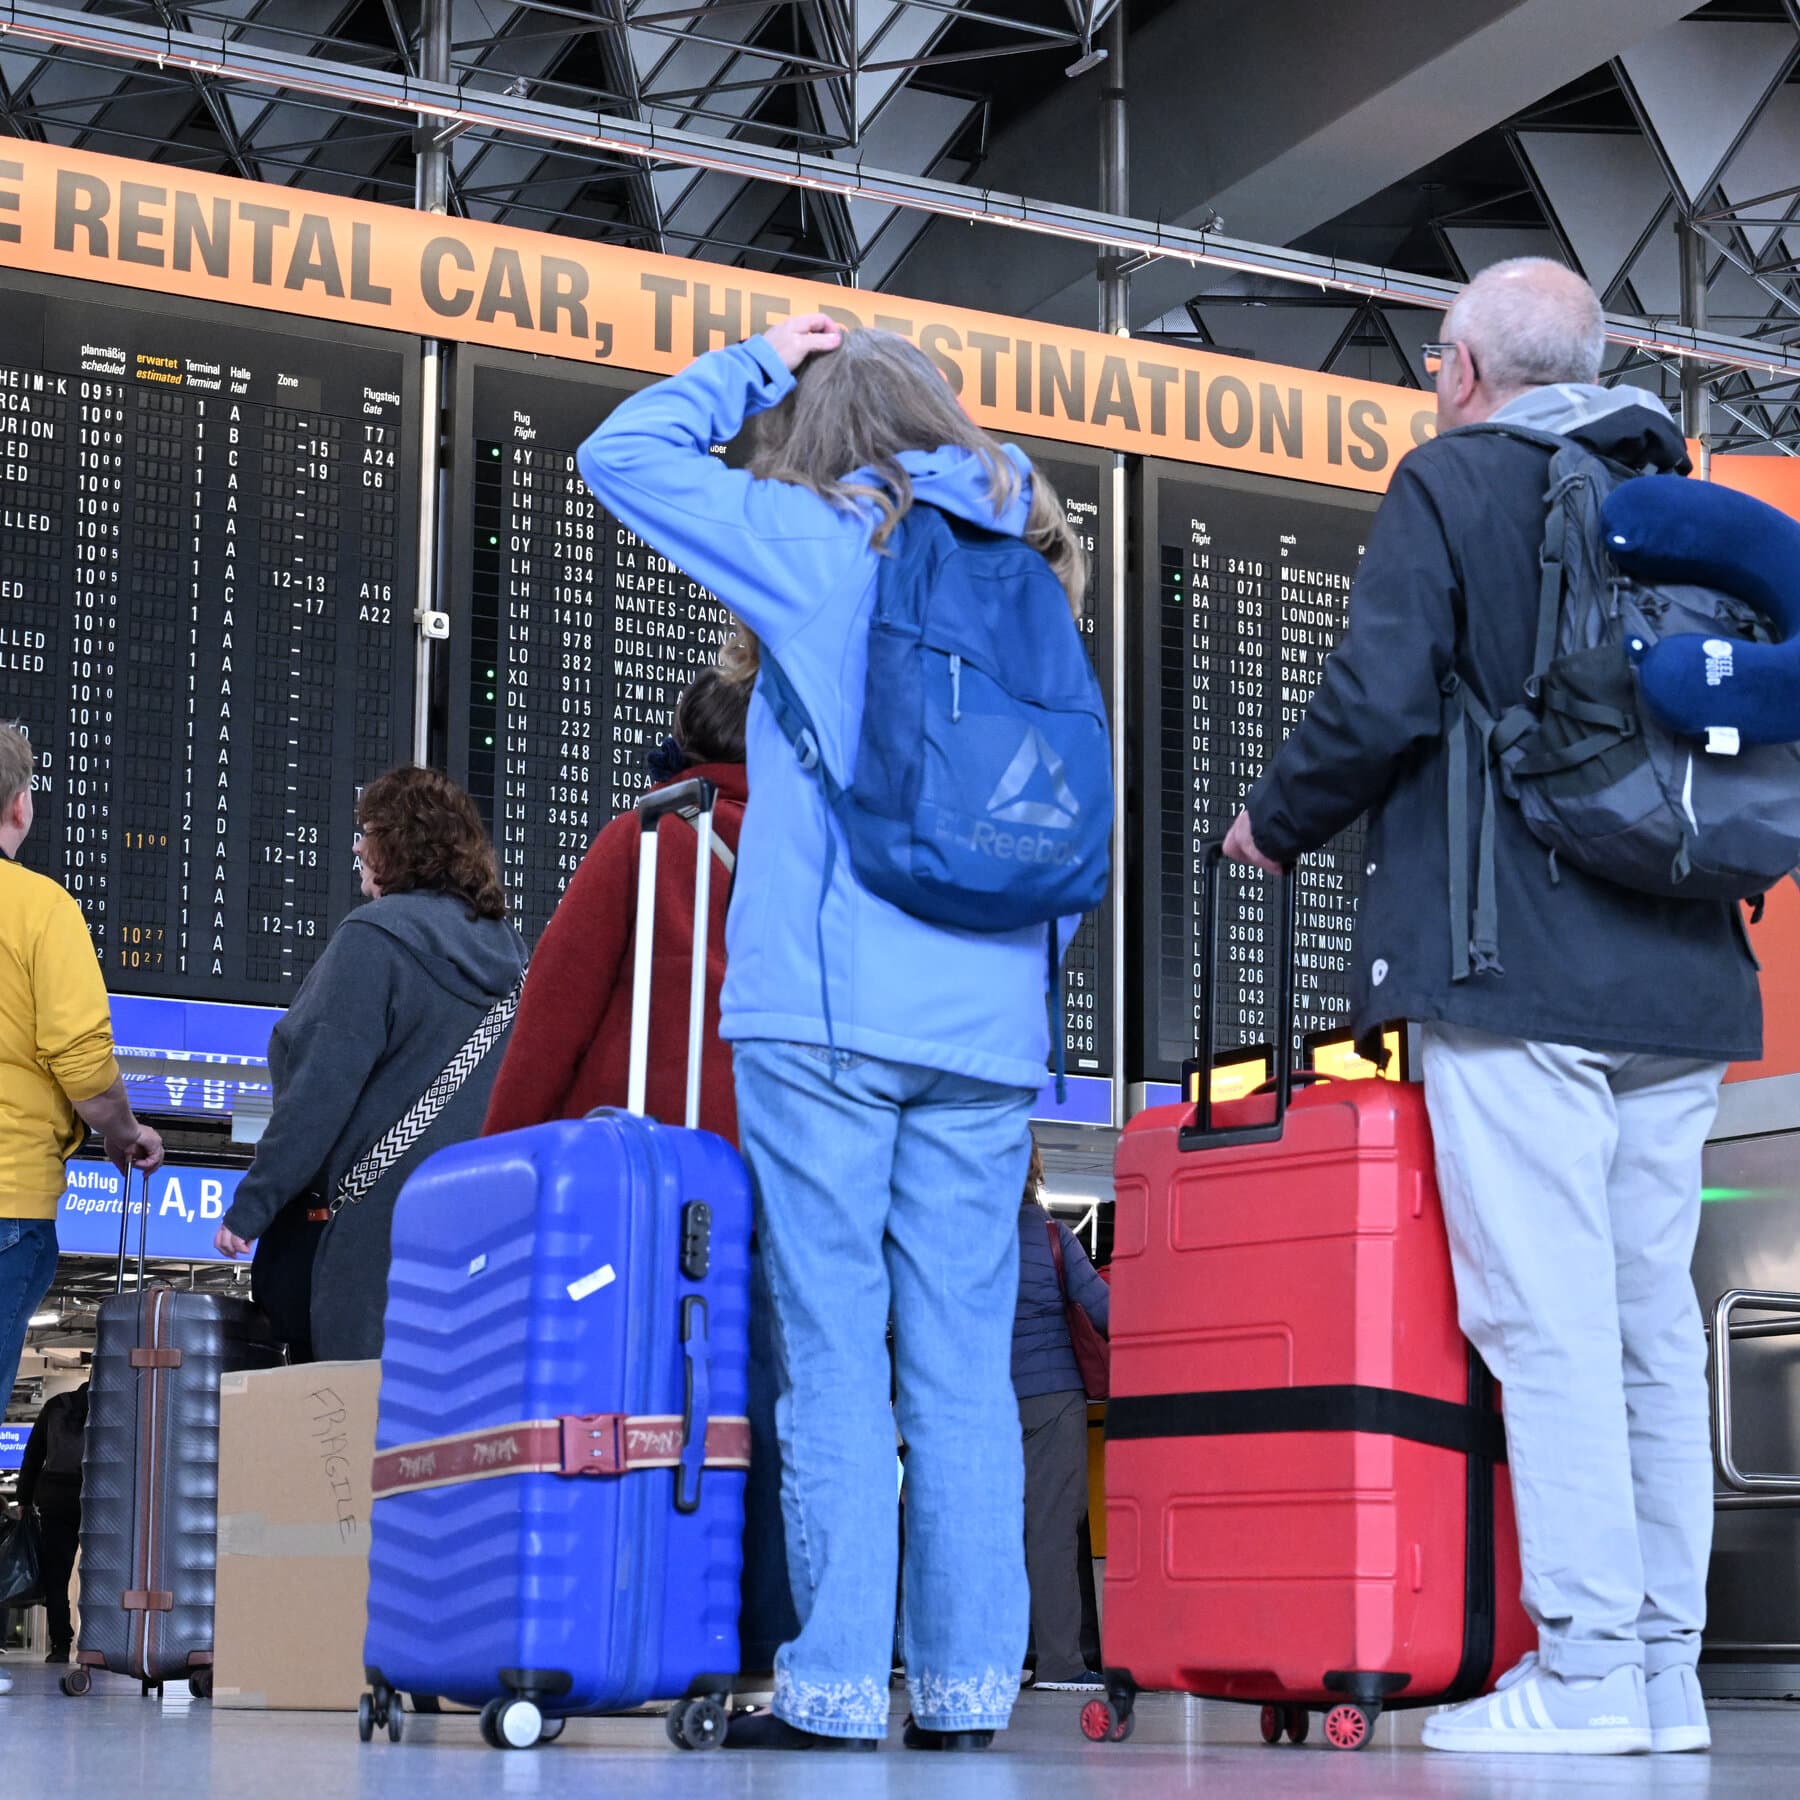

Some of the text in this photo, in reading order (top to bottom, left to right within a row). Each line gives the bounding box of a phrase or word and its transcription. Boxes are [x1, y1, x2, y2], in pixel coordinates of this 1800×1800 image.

[54, 168, 392, 306] RENTAL
[418, 236, 613, 358] CAR,
[1327, 394, 1389, 473] IS
[81, 344, 399, 405] planmäßig erwartet Terminal Halle Zone Flugsteig
[81, 360, 382, 415] scheduled estimated Terminal Hall Gate
[230, 406, 240, 421] A
[365, 426, 384, 442] T7
[514, 411, 530, 426] Flug
[514, 426, 536, 440] Flight
[230, 428, 238, 443] B
[363, 449, 394, 467] A24
[514, 449, 532, 464] 4Y
[229, 451, 238, 466] C
[363, 471, 382, 487] C6
[513, 470, 531, 487] LH
[513, 492, 594, 518] LH 802
[1067, 499, 1097, 515] Flugsteig
[1068, 513, 1083, 524] Gate
[556, 521, 593, 540] 1558
[1192, 519, 1296, 544] Flug nach
[1192, 533, 1289, 557] Flight to
[554, 543, 593, 561] 2106
[617, 551, 635, 568] LA
[1193, 553, 1208, 568] LH
[1229, 559, 1262, 576] 3410
[512, 558, 530, 575] LH
[564, 566, 593, 583] 334
[1193, 574, 1209, 588] AA
[360, 583, 390, 601] A16
[511, 580, 529, 597] LH
[555, 587, 592, 605] 1054
[1193, 593, 1209, 608] BA
[1238, 600, 1262, 616] 903
[360, 605, 390, 624] A22
[554, 609, 592, 627] 1410
[1193, 614, 1333, 647] EI 651 DUBLIN
[563, 632, 591, 649] 978
[1238, 641, 1262, 656] 400
[1282, 647, 1307, 663] NEW
[563, 654, 591, 671] 382
[1231, 660, 1262, 677] 1128
[508, 669, 664, 702] XQ 911 IZMIR
[1193, 675, 1262, 697] UX 1502
[508, 691, 526, 708] DL
[1193, 695, 1208, 710] DL
[508, 714, 590, 737] LH 232
[1194, 716, 1262, 737] LH 1356
[561, 743, 589, 760] 448
[1193, 736, 1263, 758] DE 192
[560, 765, 588, 782] 456
[1194, 756, 1262, 777] LH 1142
[507, 781, 525, 797] LH
[551, 786, 588, 804] 1364
[183, 815, 191, 830] 2
[217, 818, 225, 833] D
[549, 808, 588, 826] 3454
[1193, 818, 1209, 833] A3
[559, 832, 587, 848] 272
[970, 820, 1084, 866] Reebo
[1230, 864, 1263, 880] 8854
[1239, 886, 1263, 901] 442
[1239, 906, 1263, 921] 960
[1230, 926, 1263, 942] 3608
[1230, 946, 1263, 963] 3648
[1068, 972, 1083, 986] T5
[1240, 968, 1263, 983] 206
[1067, 993, 1092, 1008] A40
[1068, 1014, 1092, 1029] Z66
[1067, 1035, 1092, 1051] B46
[1240, 1030, 1264, 1045] 594
[66, 1171, 118, 1194] Abflug
[304, 1386, 357, 1545] FRAGILE
[1588, 1715, 1629, 1726] adidas
